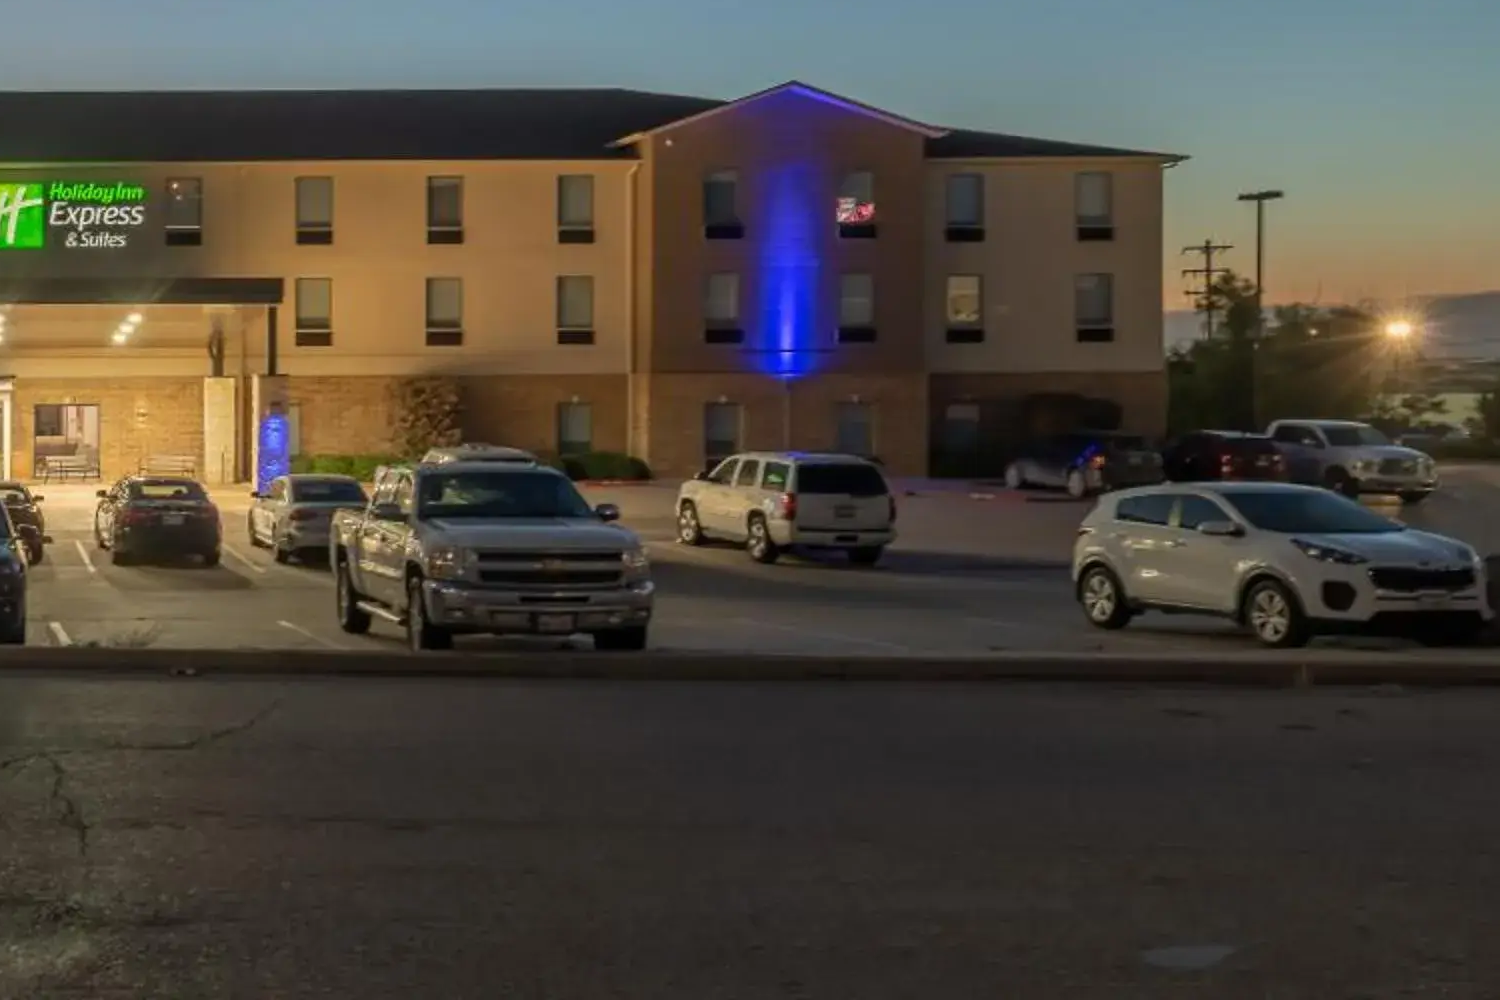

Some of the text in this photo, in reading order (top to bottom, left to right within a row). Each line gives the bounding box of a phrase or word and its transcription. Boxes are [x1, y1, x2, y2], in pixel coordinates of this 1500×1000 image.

[50, 181, 144, 203] Holiday Inn
[49, 201, 145, 231] Express
[65, 231, 127, 247] & Suites
